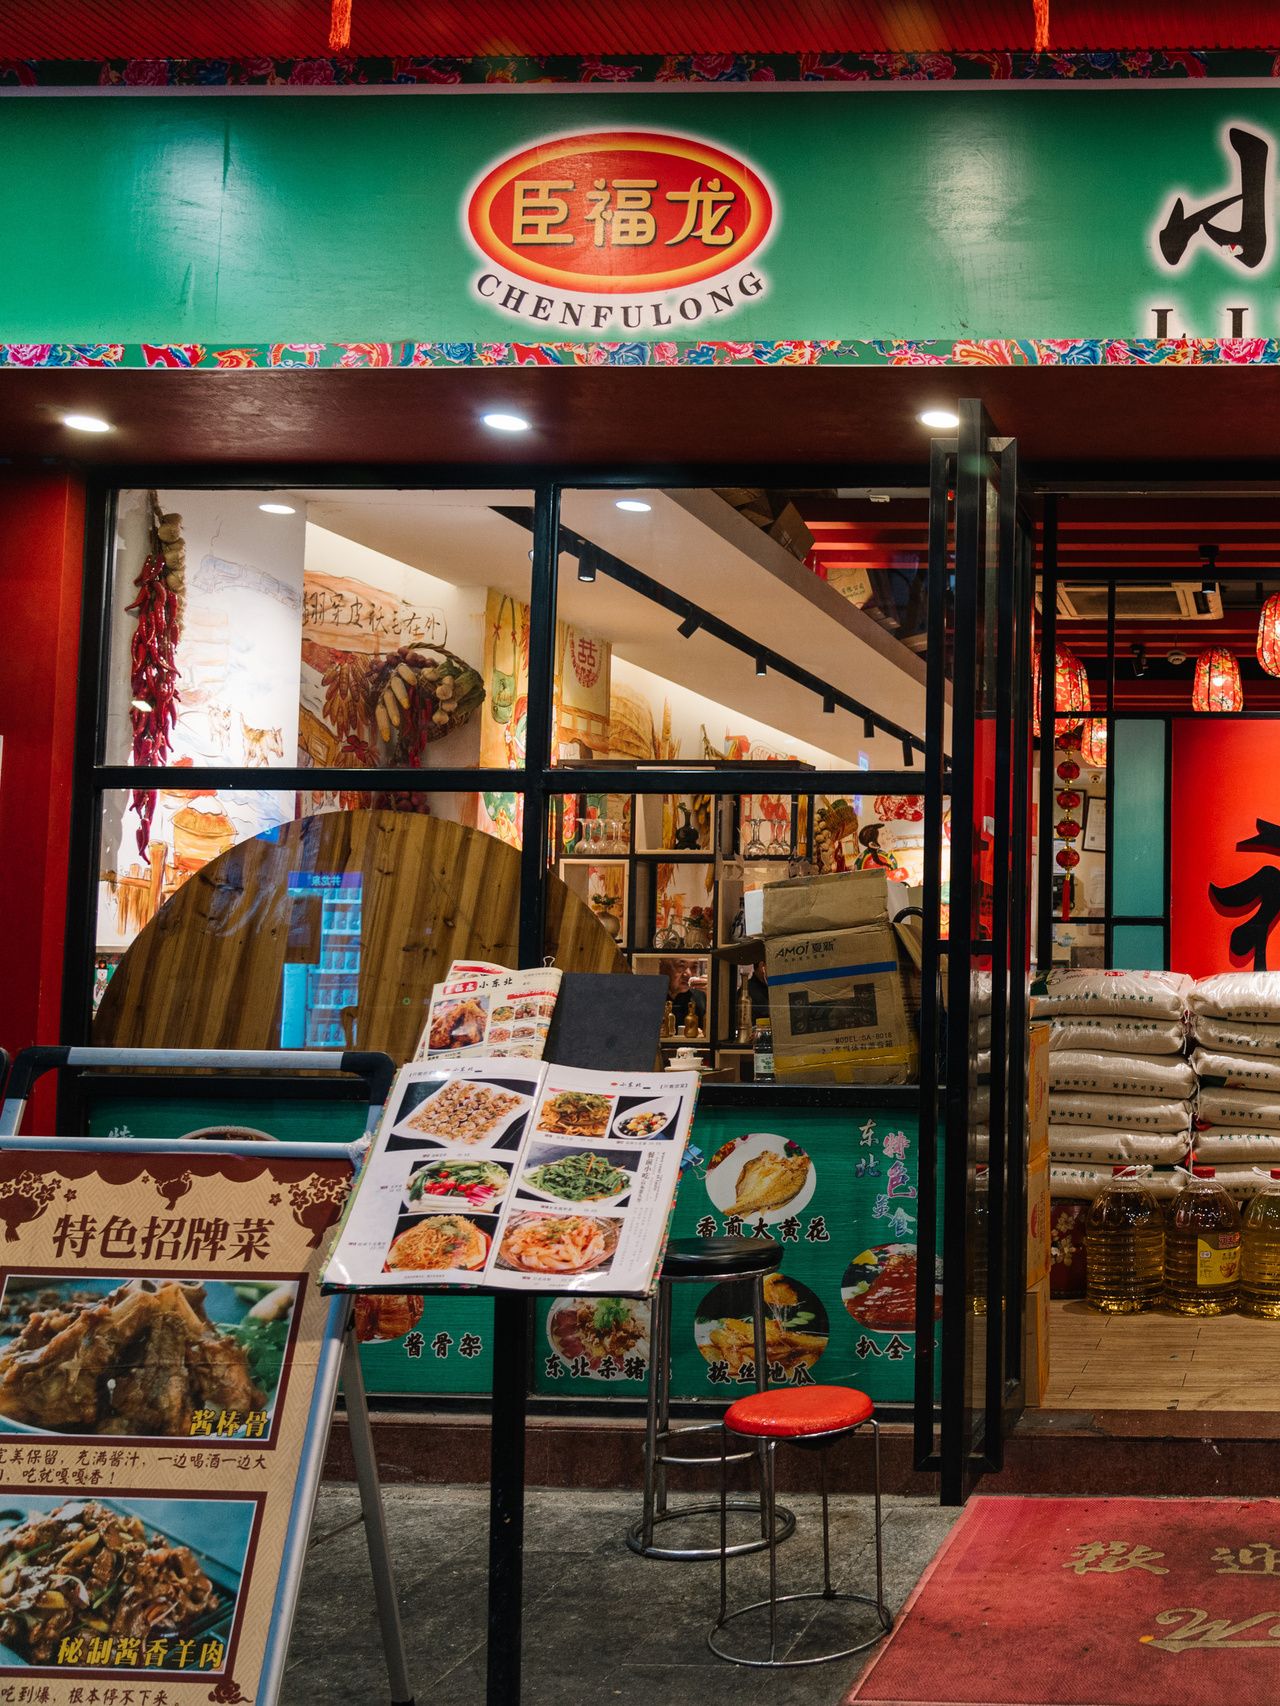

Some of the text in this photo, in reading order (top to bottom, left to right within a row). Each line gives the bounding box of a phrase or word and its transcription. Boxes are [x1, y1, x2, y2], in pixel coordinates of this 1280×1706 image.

[512, 177, 736, 247] 臣福龙
[476, 271, 764, 329] CHENFULONG
[855, 1119, 882, 1179] 东北
[882, 1131, 917, 1198] 特色
[52, 1214, 275, 1263] 特色招牌菜
[696, 1215, 830, 1243] 香煎大黄花
[403, 1331, 483, 1360] 酱骨架
[544, 1351, 673, 1384] 东北杀猪
[707, 1361, 817, 1386] 拔丝地瓜
[189, 1409, 270, 1438] 酱棒骨
[57, 1636, 225, 1669] 秘制酱香羊肉
